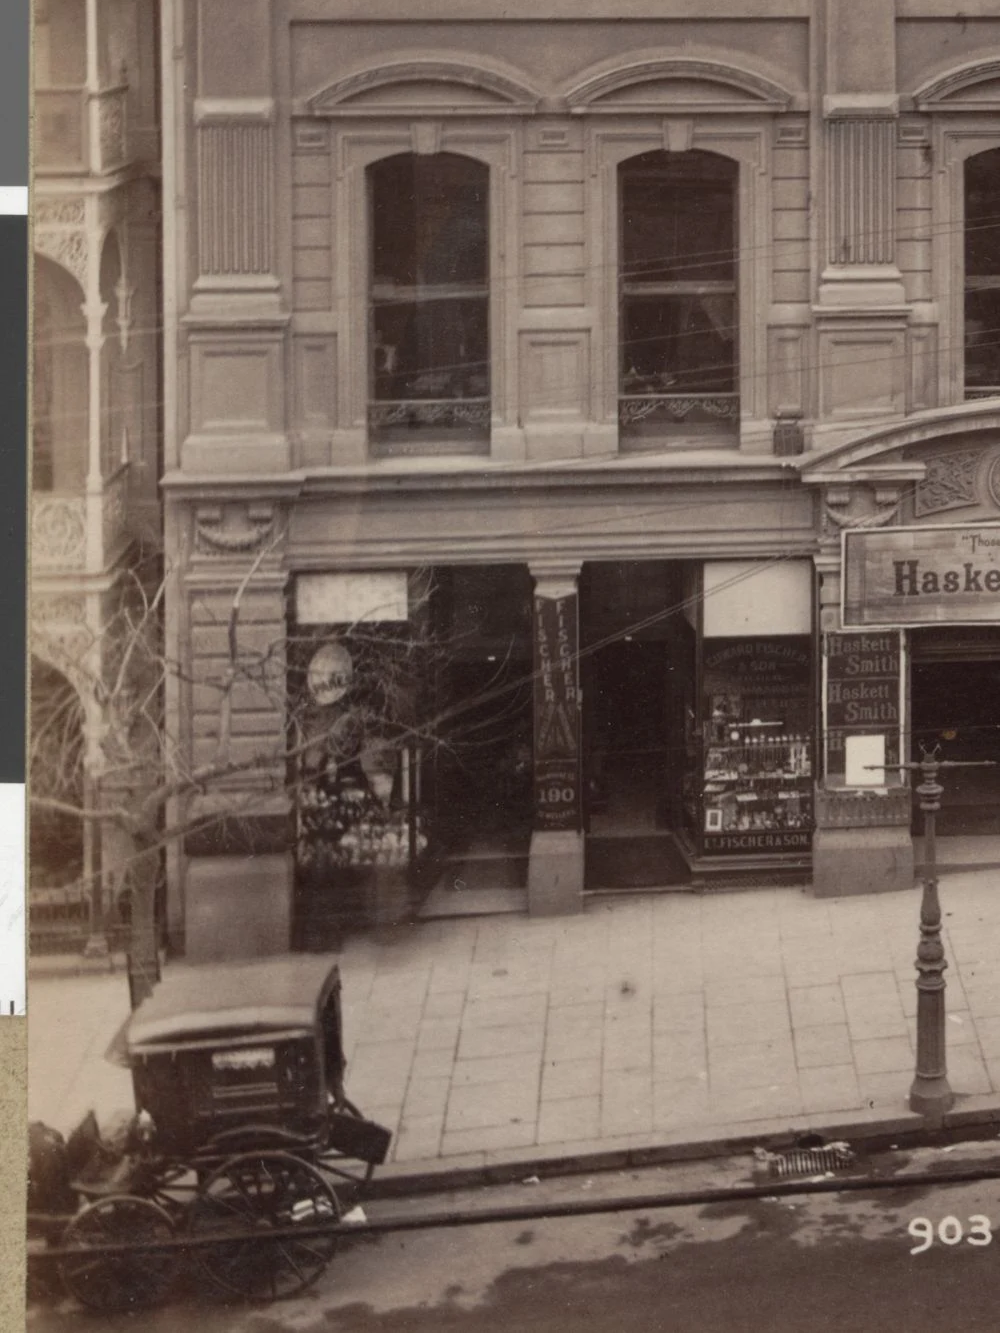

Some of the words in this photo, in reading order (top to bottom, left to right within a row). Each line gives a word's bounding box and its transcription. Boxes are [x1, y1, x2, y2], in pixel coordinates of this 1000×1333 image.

[827, 634, 891, 656] Haskett
[845, 654, 898, 675] Smith
[827, 682, 890, 703] Haskett
[844, 701, 898, 722] Smith
